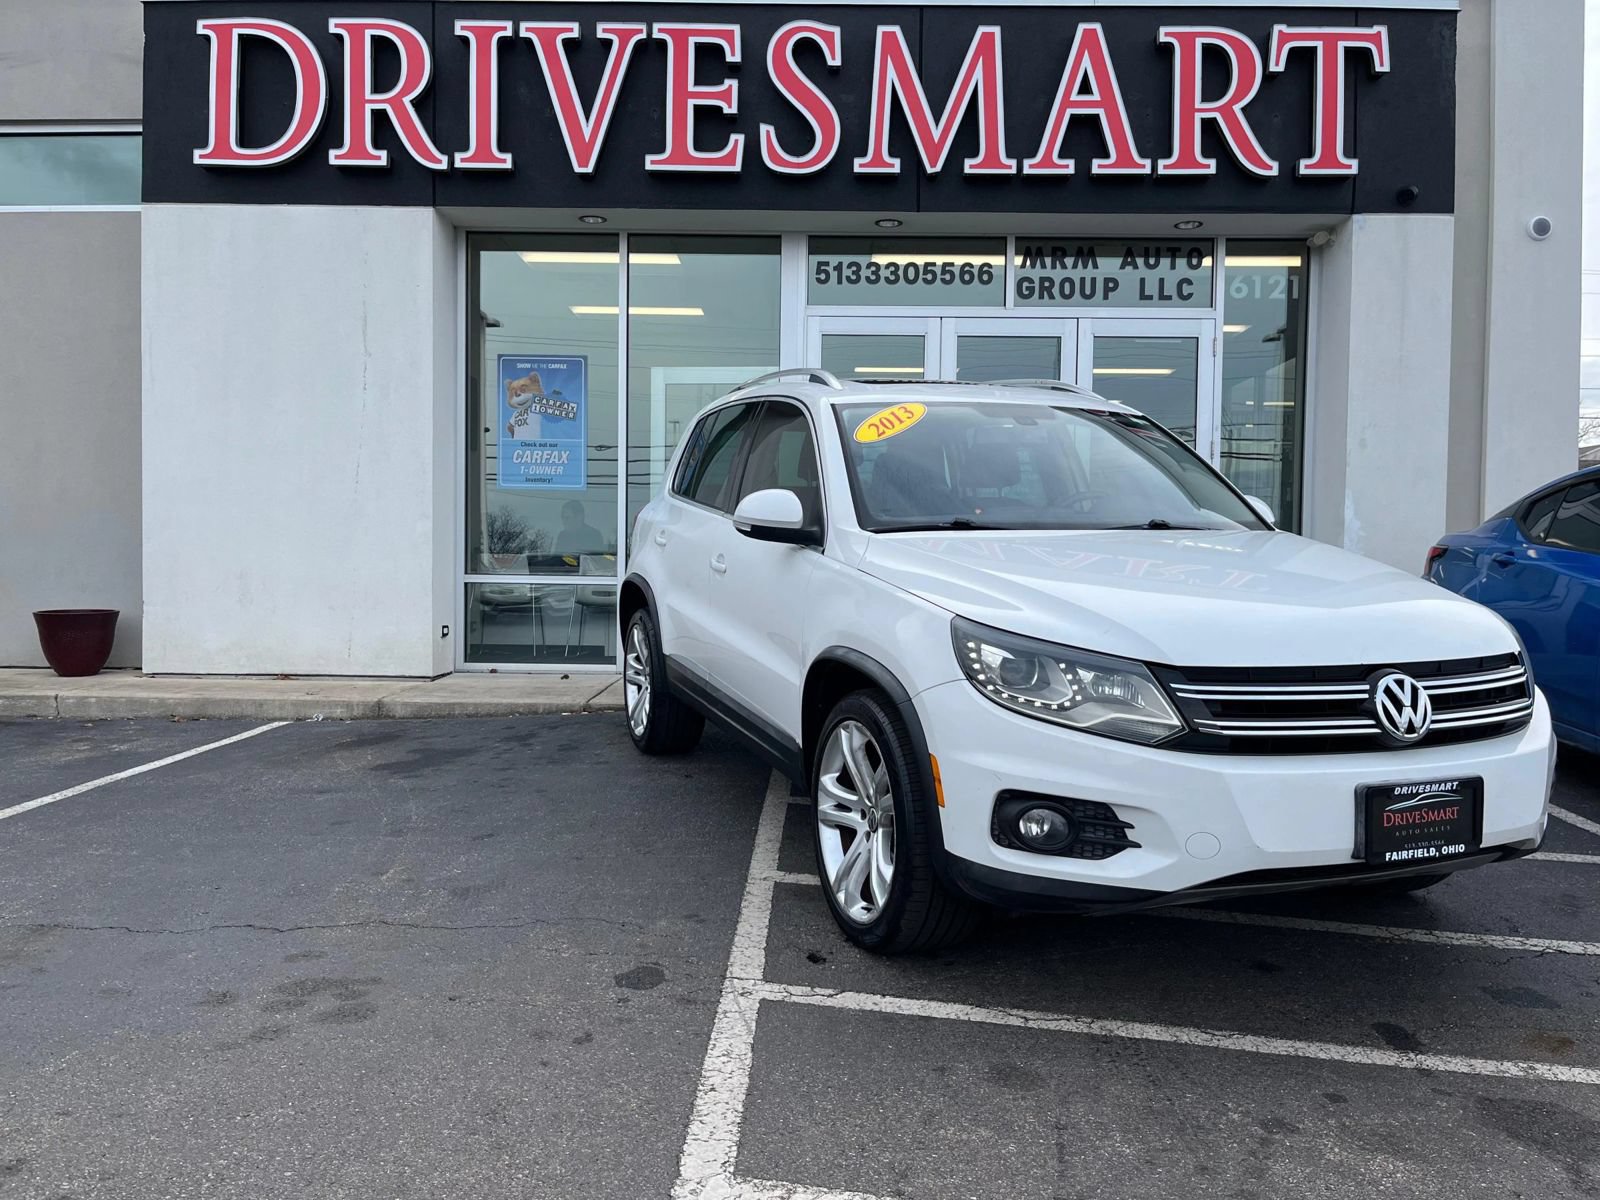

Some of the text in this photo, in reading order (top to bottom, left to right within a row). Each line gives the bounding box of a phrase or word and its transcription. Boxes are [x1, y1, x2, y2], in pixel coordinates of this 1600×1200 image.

[192, 16, 1391, 178] DRIVESMART
[1019, 246, 1206, 271] MRM AUTO
[814, 260, 995, 287] 5133305566
[1016, 276, 1195, 302] GROUP LLC
[1229, 275, 1302, 301] 6121
[533, 396, 577, 412] CARFAX
[514, 410, 529, 419] CAR
[514, 417, 529, 427] FOX
[867, 406, 914, 437] 2013
[513, 449, 570, 464] CARFAX
[520, 465, 564, 475] 1-OWNER
[1394, 781, 1459, 796] DRIVESMART
[1395, 825, 1451, 837] AUTO SALES
[1385, 843, 1466, 862] FAIRFIELD, OHIO
